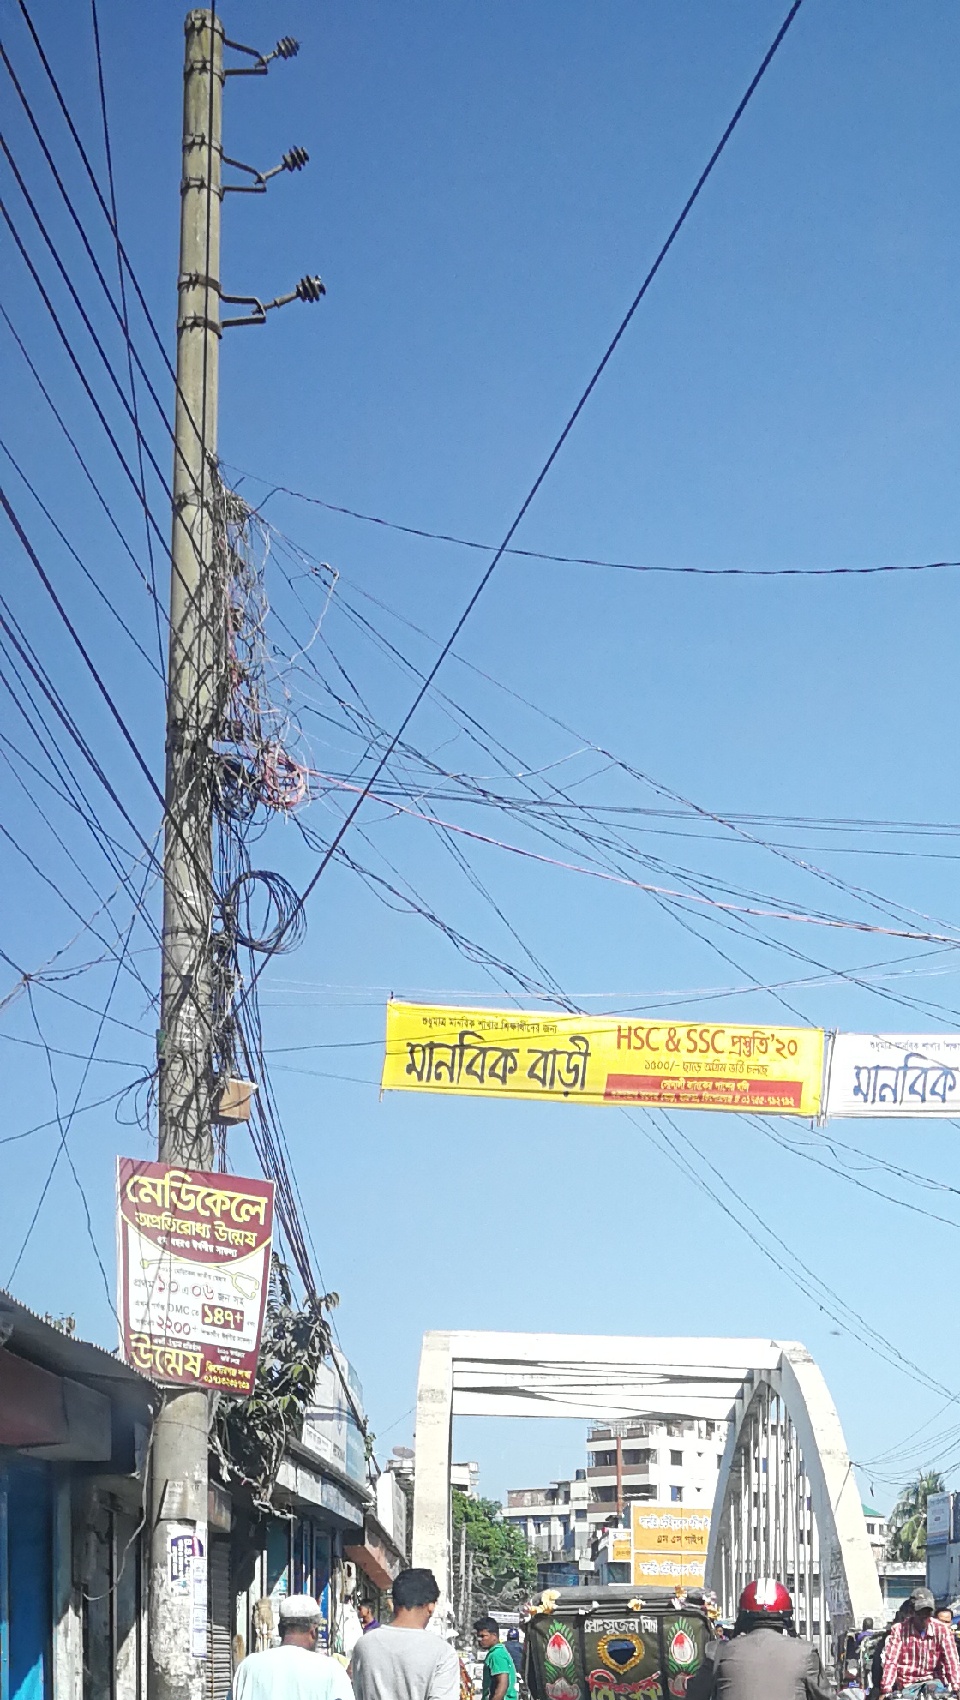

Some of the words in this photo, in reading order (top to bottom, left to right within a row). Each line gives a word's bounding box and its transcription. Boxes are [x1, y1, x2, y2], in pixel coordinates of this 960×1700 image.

[616, 1025, 660, 1051] HSC
[665, 1026, 681, 1053] &
[686, 1028, 726, 1054] SSC
[406, 1030, 520, 1084] মানবিক
[527, 1035, 591, 1097] বাড়ী
[853, 1052, 959, 1105] মানবিক
[125, 1170, 268, 1226] মেডিকেলে
[134, 1211, 211, 1239] অপ্রতিরোধ্য
[213, 1220, 258, 1248] উন্মেষ
[157, 1274, 179, 1293] ১০
[191, 1284, 215, 1301] ০৬
[167, 1303, 190, 1316] DMC
[203, 1304, 244, 1329] ১৪৭+
[129, 1333, 204, 1378] উন্মেষ
